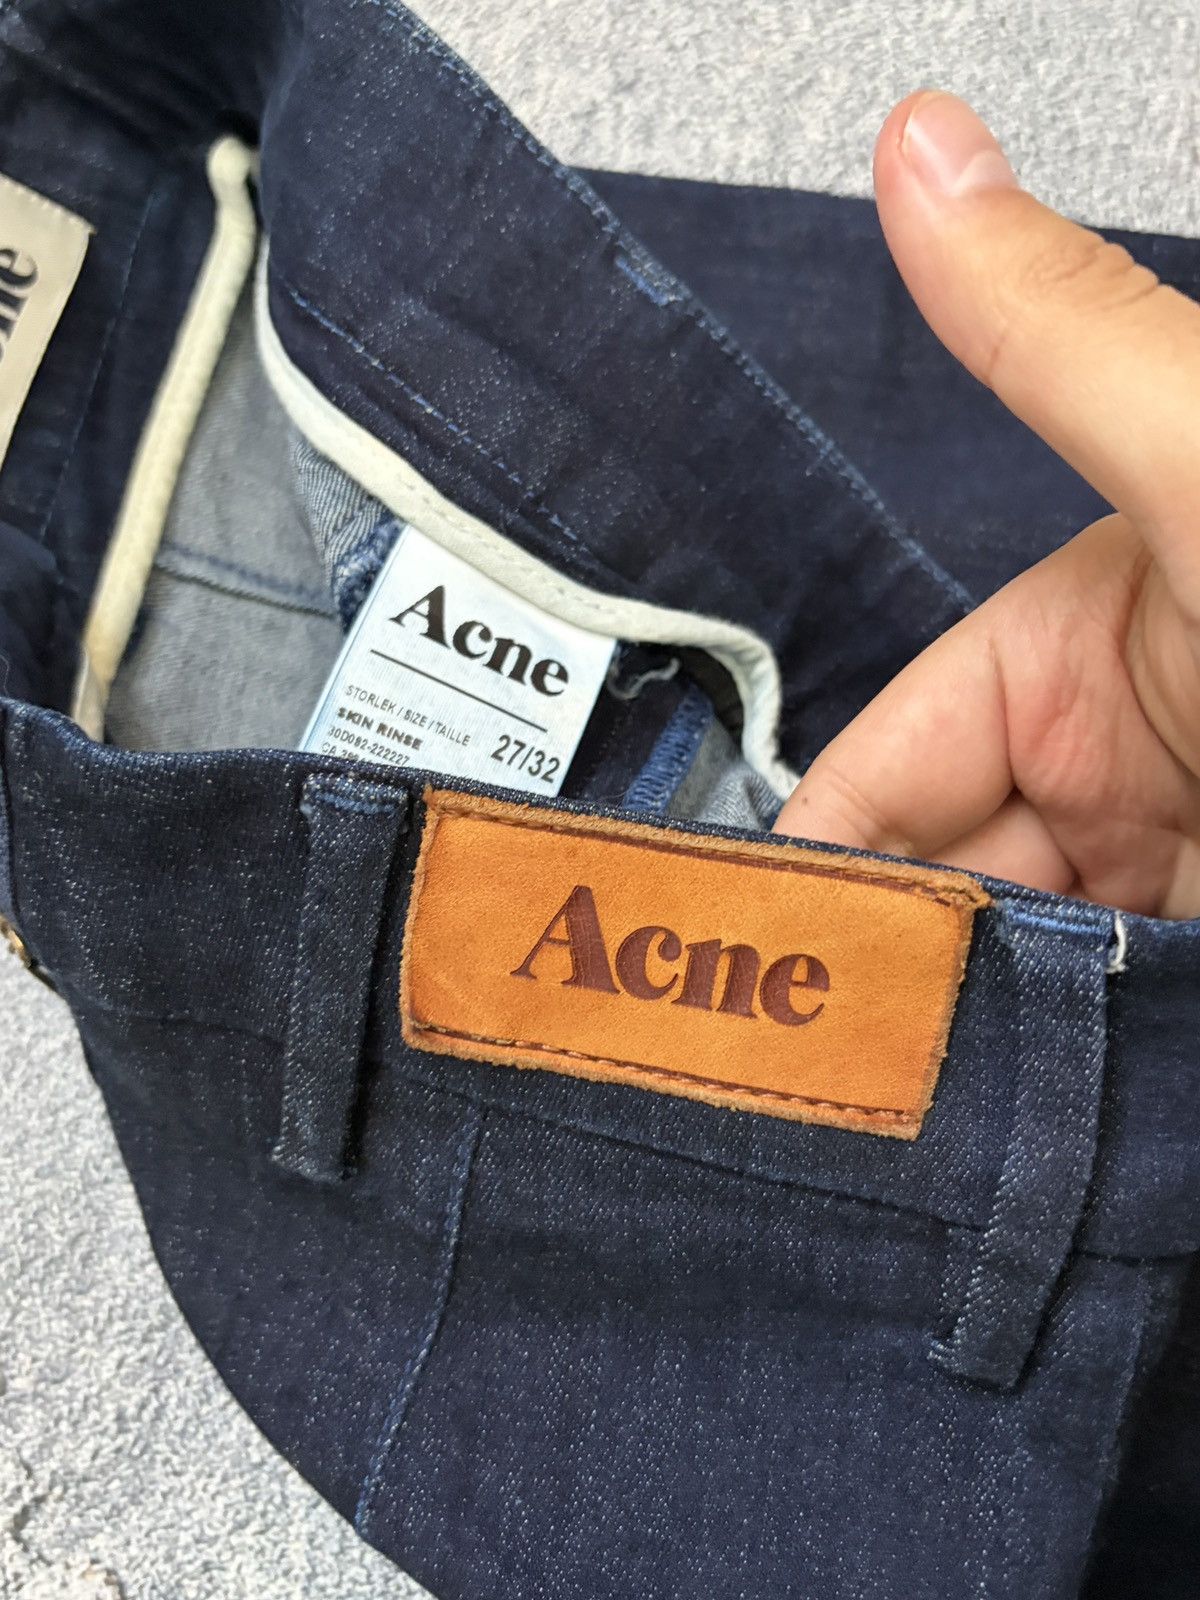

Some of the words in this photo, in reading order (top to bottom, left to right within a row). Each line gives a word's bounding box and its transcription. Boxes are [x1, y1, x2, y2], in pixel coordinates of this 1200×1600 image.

[388, 585, 569, 697] Acne
[345, 685, 397, 714] STORLEK
[403, 709, 428, 727] SIZE
[435, 721, 471, 747] TAILLE
[376, 722, 424, 750] RINSE
[491, 734, 560, 783] 27/32
[510, 885, 830, 1026] Acne
